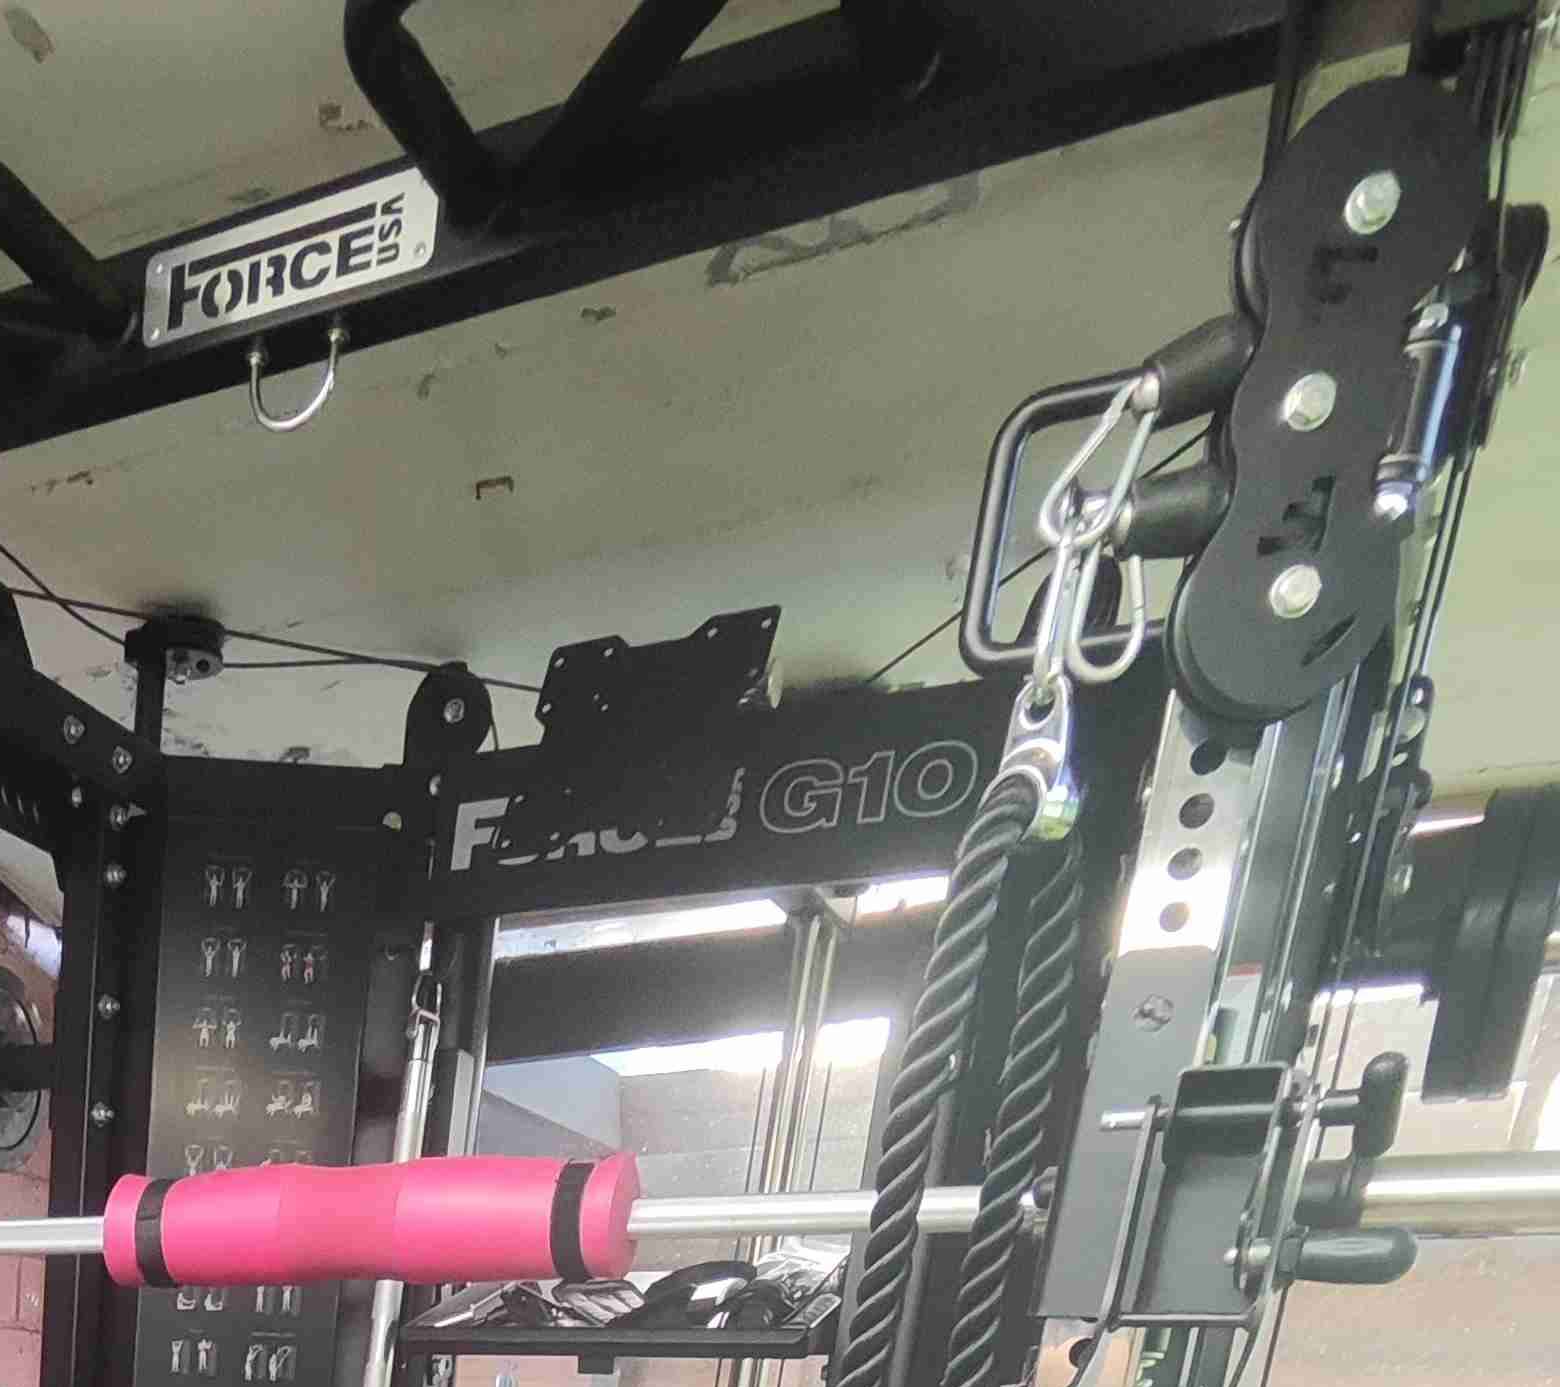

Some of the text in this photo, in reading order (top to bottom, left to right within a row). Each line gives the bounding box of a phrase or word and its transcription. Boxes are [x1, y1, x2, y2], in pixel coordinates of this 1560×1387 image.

[167, 191, 405, 331] FORCE USA
[760, 740, 978, 833] G10
